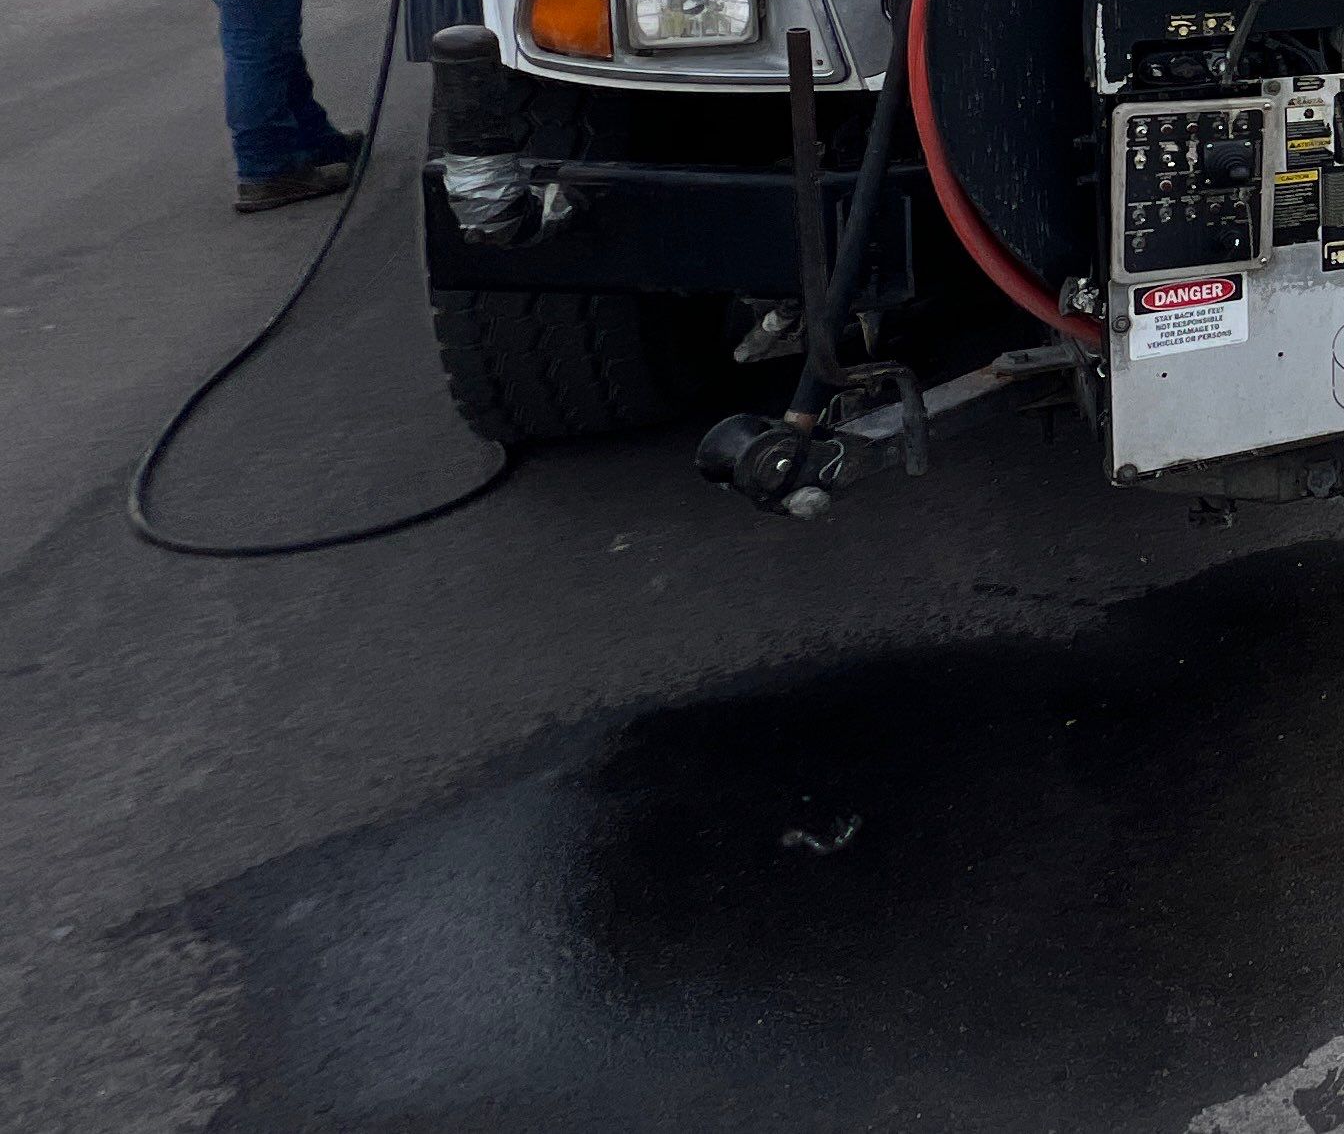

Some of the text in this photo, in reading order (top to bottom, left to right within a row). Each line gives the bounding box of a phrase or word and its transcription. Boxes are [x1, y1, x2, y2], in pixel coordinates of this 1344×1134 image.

[1154, 283, 1223, 307] DANGER
[1154, 315, 1173, 323] STAY
[1174, 311, 1194, 320] BACK
[1207, 306, 1224, 315] FEET
[1155, 315, 1223, 331] NOT RESPONSIBLE
[1146, 338, 1184, 349] VEHICLES
[1185, 335, 1196, 343] OR
[1197, 330, 1232, 341] PERSONS
[1160, 323, 1220, 339] FOR DAMAGE TO
